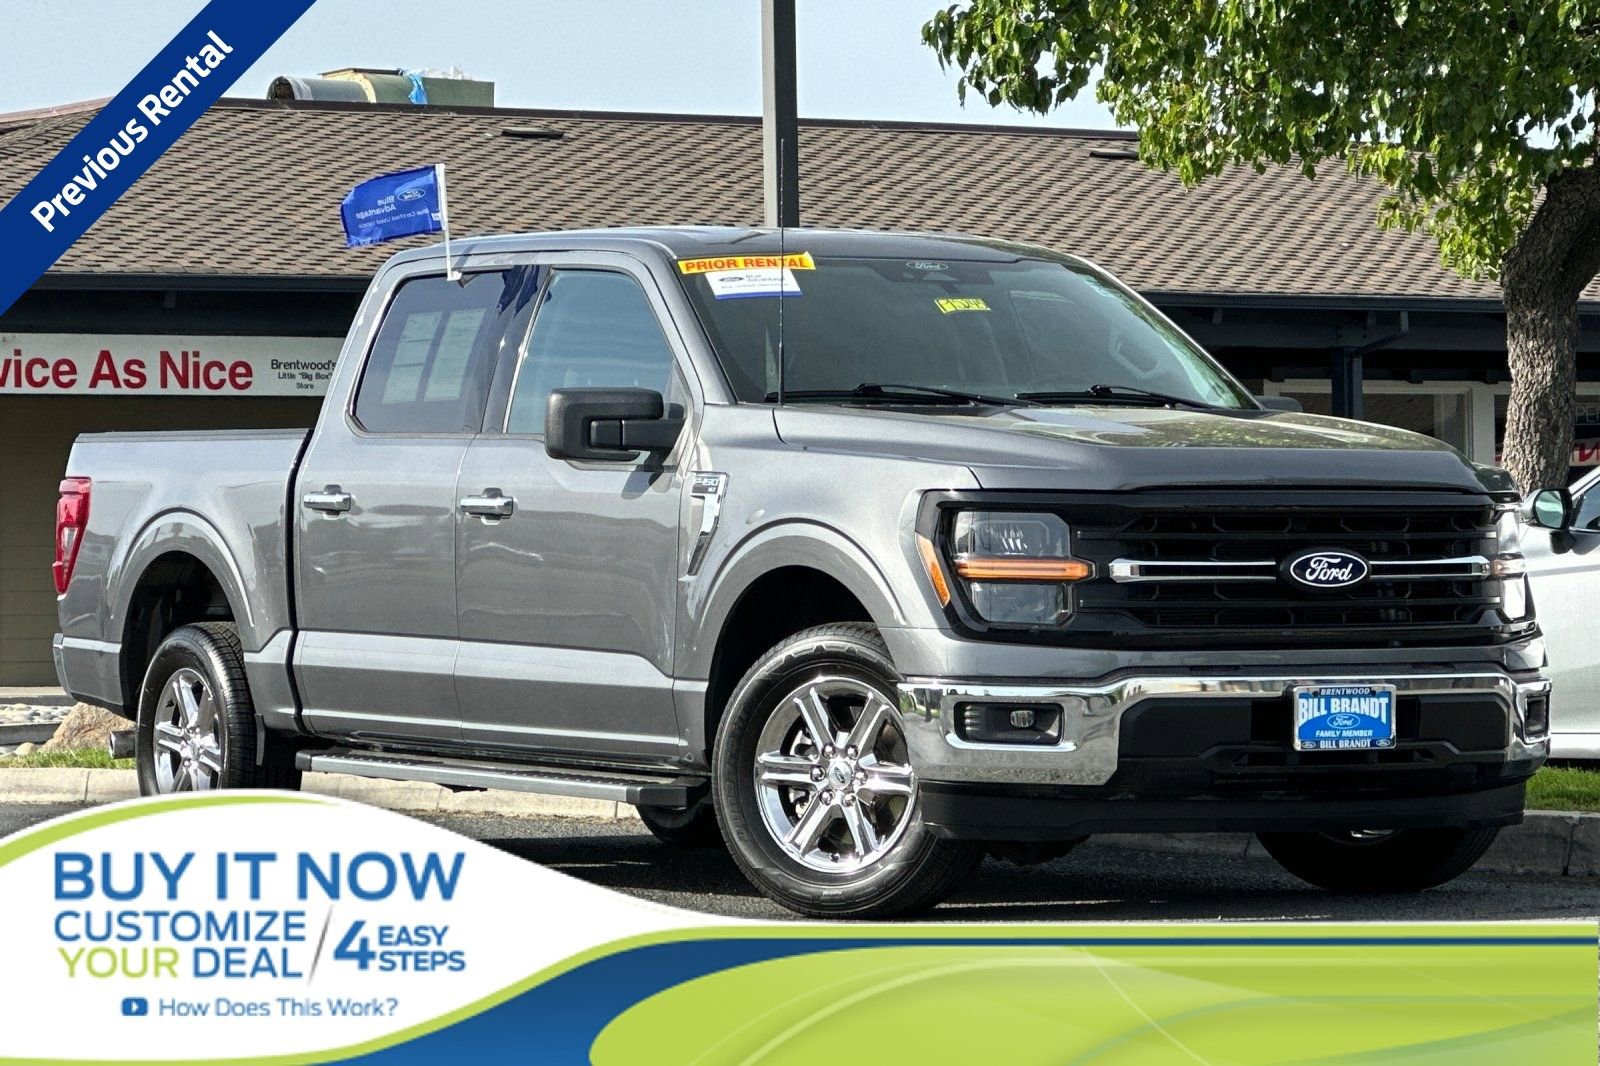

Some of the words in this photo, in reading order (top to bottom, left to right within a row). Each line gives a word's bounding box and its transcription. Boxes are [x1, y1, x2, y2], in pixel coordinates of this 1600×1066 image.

[684, 258, 739, 272] PRIOR
[743, 257, 809, 270] RENTAL
[89, 350, 147, 390] As
[159, 350, 254, 391] Nice
[277, 372, 296, 380] Little
[296, 382, 314, 390] Store
[1305, 556, 1353, 581] Ford
[1320, 687, 1371, 696] BRENTWOOD
[1299, 697, 1328, 727] BILL
[1330, 697, 1389, 725] BRANDT
[1315, 730, 1341, 738] FAMILY
[1341, 729, 1374, 737] MEMBER
[1320, 740, 1337, 749] BILL
[1338, 739, 1372, 749] BRANDT
